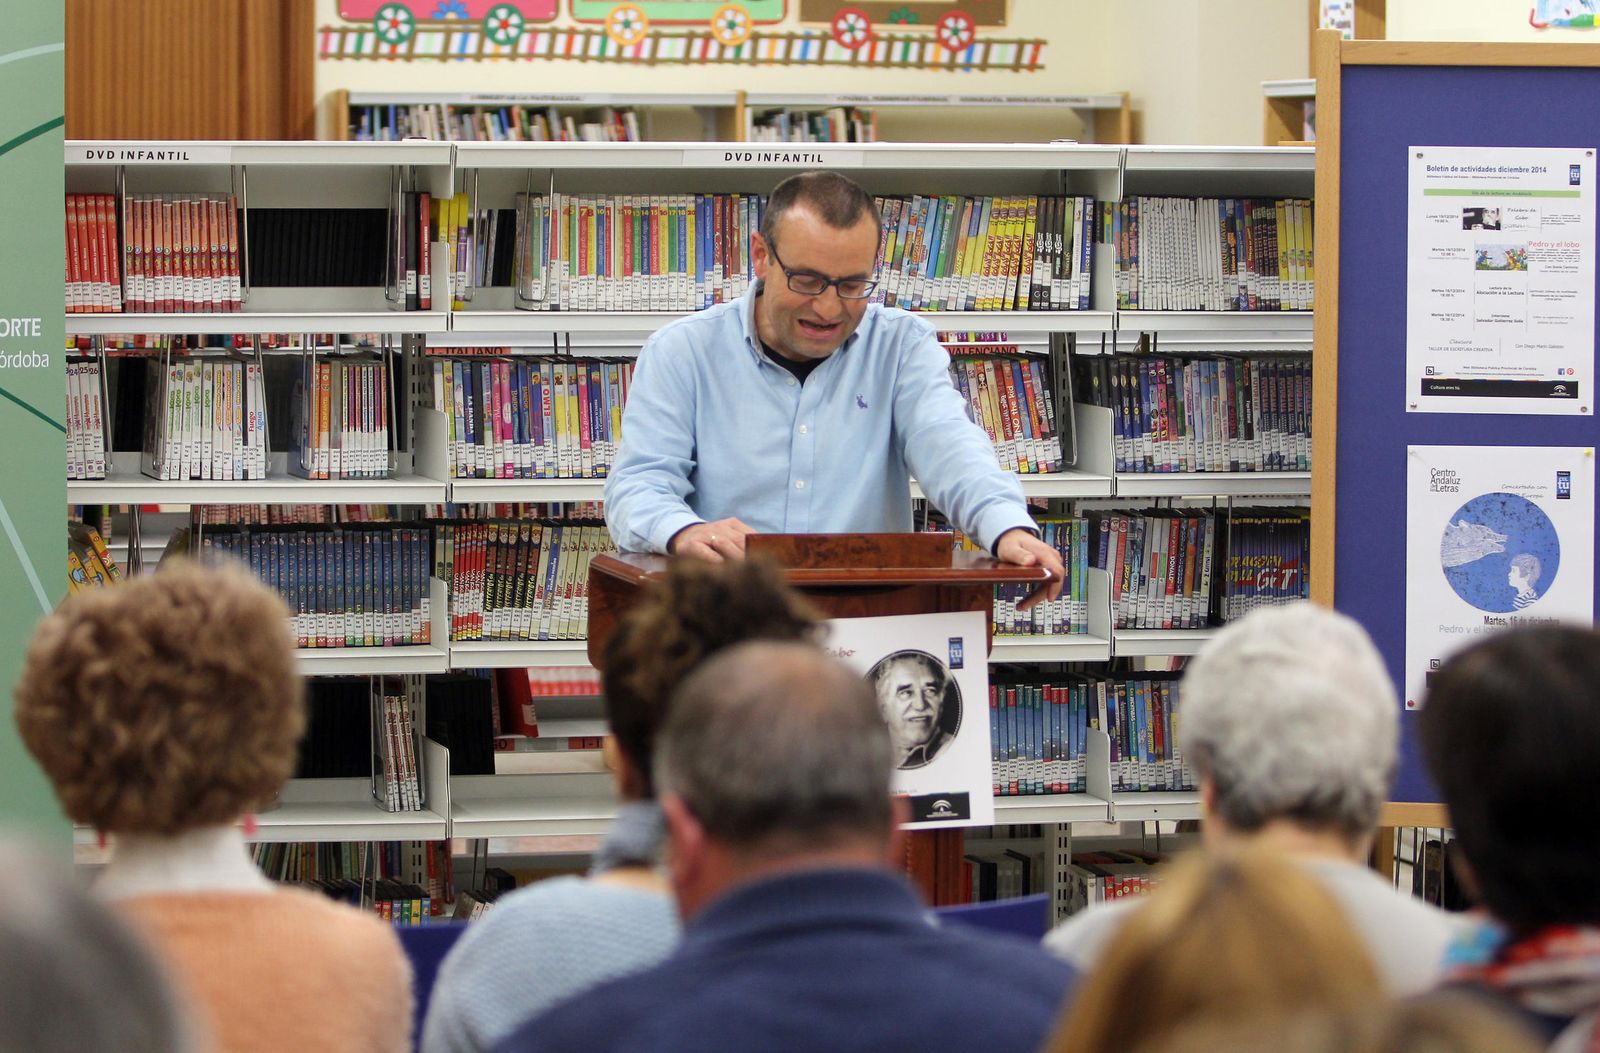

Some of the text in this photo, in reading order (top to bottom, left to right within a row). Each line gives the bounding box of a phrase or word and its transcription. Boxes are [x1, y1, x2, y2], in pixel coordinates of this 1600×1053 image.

[86, 150, 190, 160] DVD INFANTIL
[725, 152, 824, 163] DVD INFANTIL
[1451, 165, 1458, 173] de
[1460, 165, 1496, 174] actividades
[1498, 165, 1530, 174] diciembre
[1531, 166, 1546, 174] 2014
[580, 208, 587, 216] 7
[0, 318, 41, 338] ORTE
[0, 350, 49, 368] órdoba
[1010, 402, 1019, 416] the
[1012, 418, 1023, 434] NO
[1430, 468, 1456, 476] Centro
[1430, 475, 1461, 484] Andaluz
[1436, 484, 1459, 492] Letras
[1257, 568, 1298, 591] GT
[1484, 616, 1508, 626] Martes,
[1439, 625, 1463, 633] Pedro
